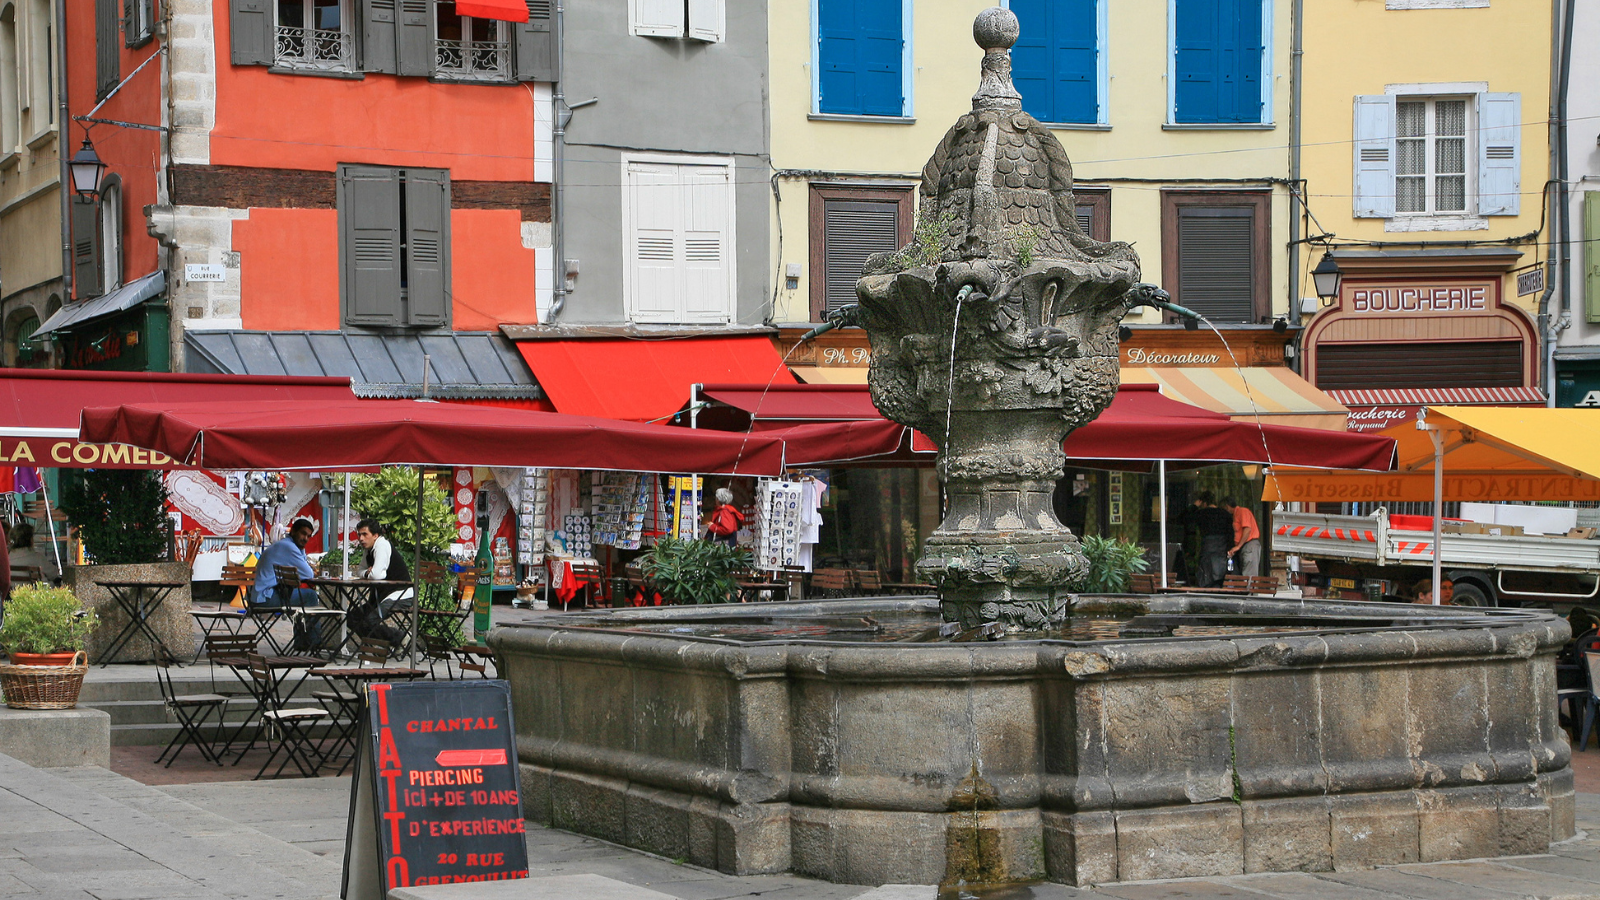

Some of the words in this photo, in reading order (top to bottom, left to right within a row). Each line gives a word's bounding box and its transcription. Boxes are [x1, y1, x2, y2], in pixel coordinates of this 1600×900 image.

[1353, 288, 1486, 313] BOUCHERIE
[823, 347, 849, 364] Ph.
[1127, 347, 1220, 364] Décorateur
[1346, 419, 1388, 432] Reynaud
[50, 441, 197, 466] COMED
[406, 717, 498, 733] CHANTAL
[409, 768, 484, 786] PIERCING
[437, 854, 458, 865] 20
[466, 852, 505, 866] RUE
